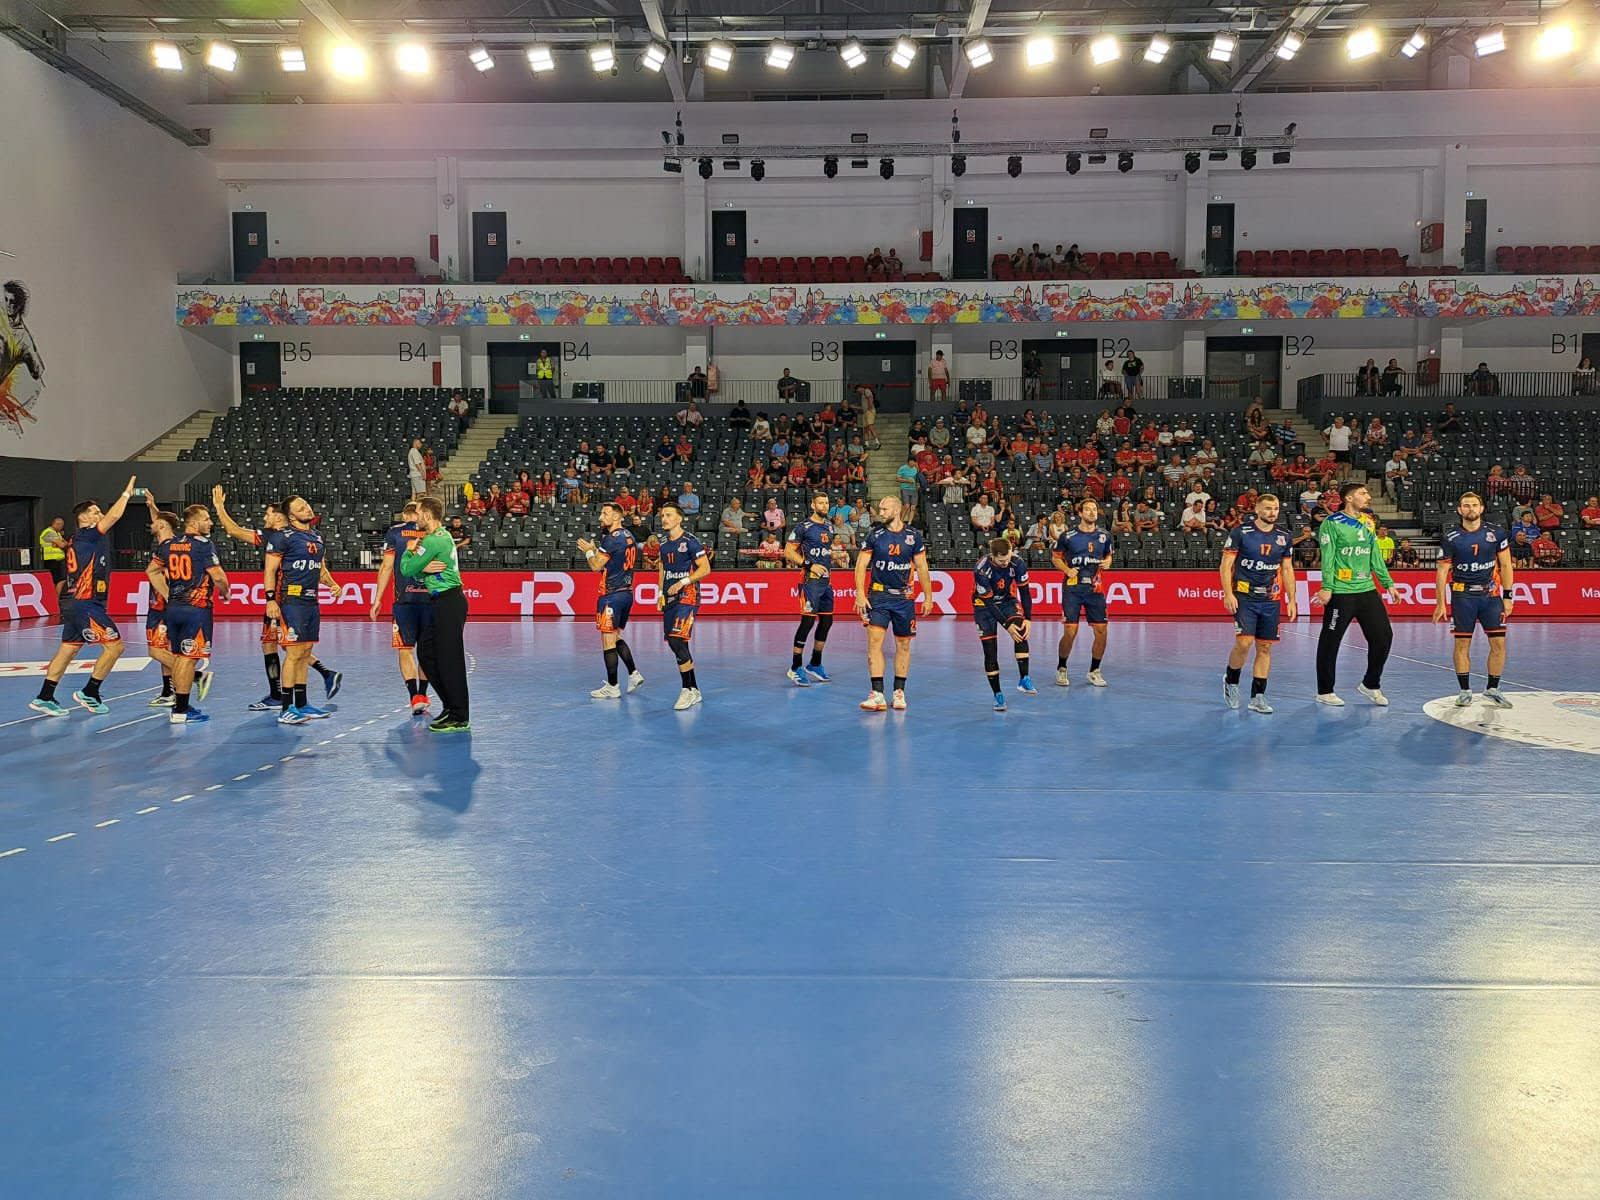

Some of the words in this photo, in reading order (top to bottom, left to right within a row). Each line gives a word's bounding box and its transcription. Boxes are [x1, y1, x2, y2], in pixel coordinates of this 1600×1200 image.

[283, 341, 312, 362] B5
[399, 341, 428, 362] B4
[563, 341, 592, 362] B4
[811, 341, 839, 362] B3
[989, 339, 1018, 361] B3
[1101, 337, 1130, 359] B2
[1285, 335, 1315, 356] B2
[1551, 333, 1578, 354] B1
[1356, 530, 1365, 541] 1
[667, 552, 674, 564] 11
[888, 543, 901, 556] 24
[1259, 543, 1272, 556] 17
[1471, 543, 1480, 556] 7
[169, 554, 193, 580] 90
[1177, 587, 1200, 599] Mai
[1581, 587, 1600, 599] Ma
